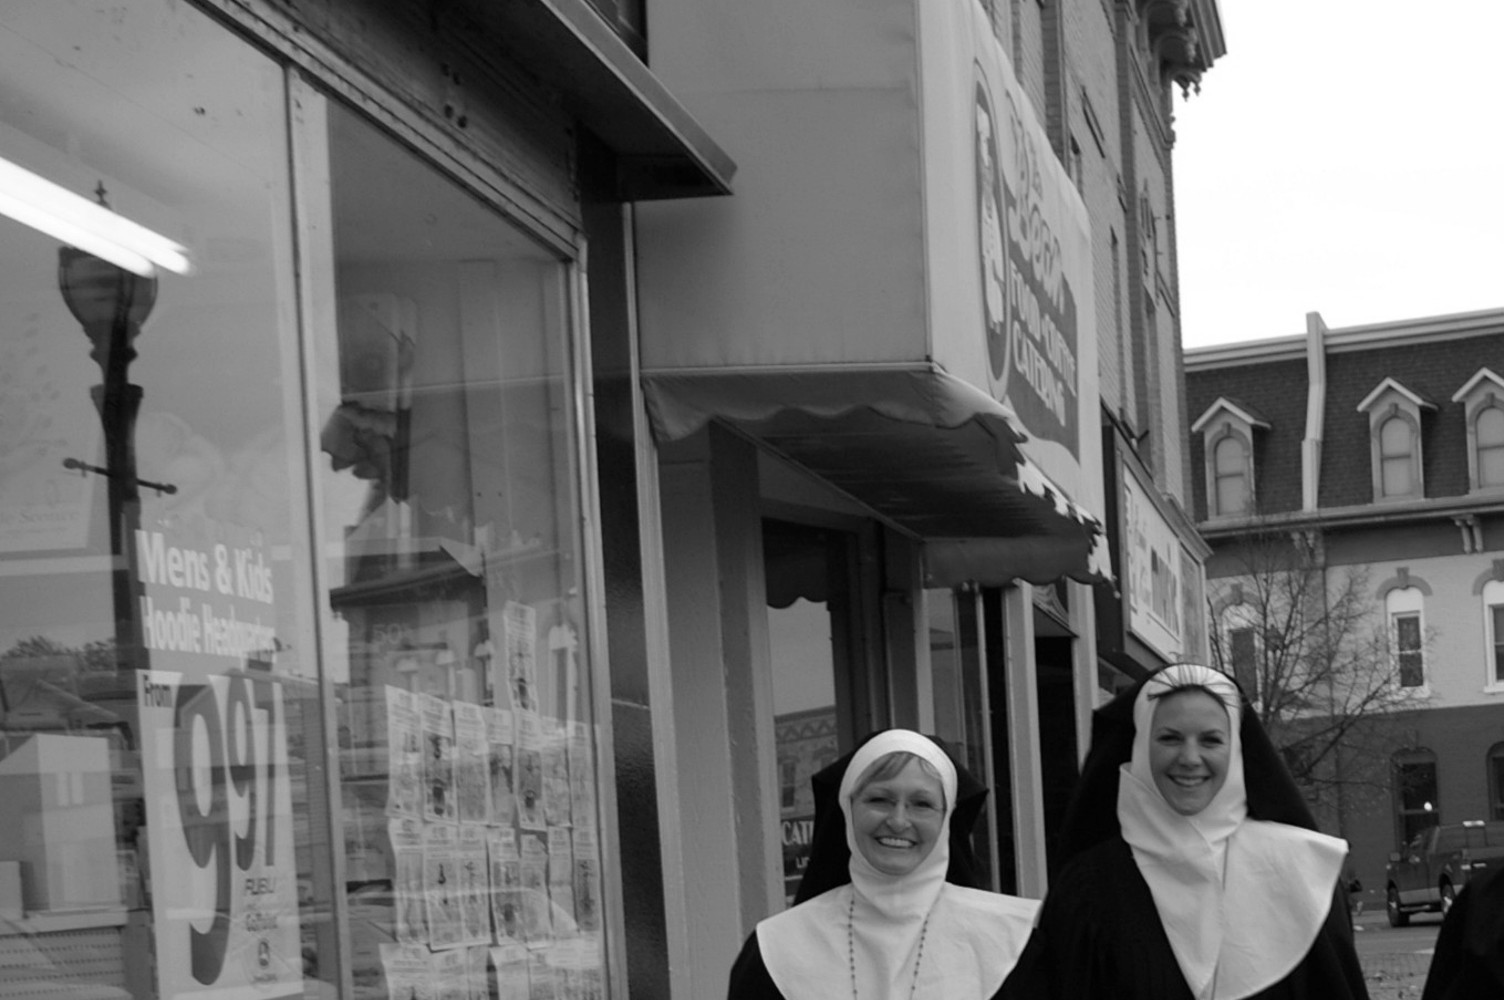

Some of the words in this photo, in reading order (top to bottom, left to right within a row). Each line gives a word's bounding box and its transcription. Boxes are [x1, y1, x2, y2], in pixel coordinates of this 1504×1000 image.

[135, 530, 211, 592] Mens
[215, 543, 234, 596] &
[234, 548, 275, 604] Kids
[139, 595, 202, 653] Hoodie
[143, 674, 174, 708] From
